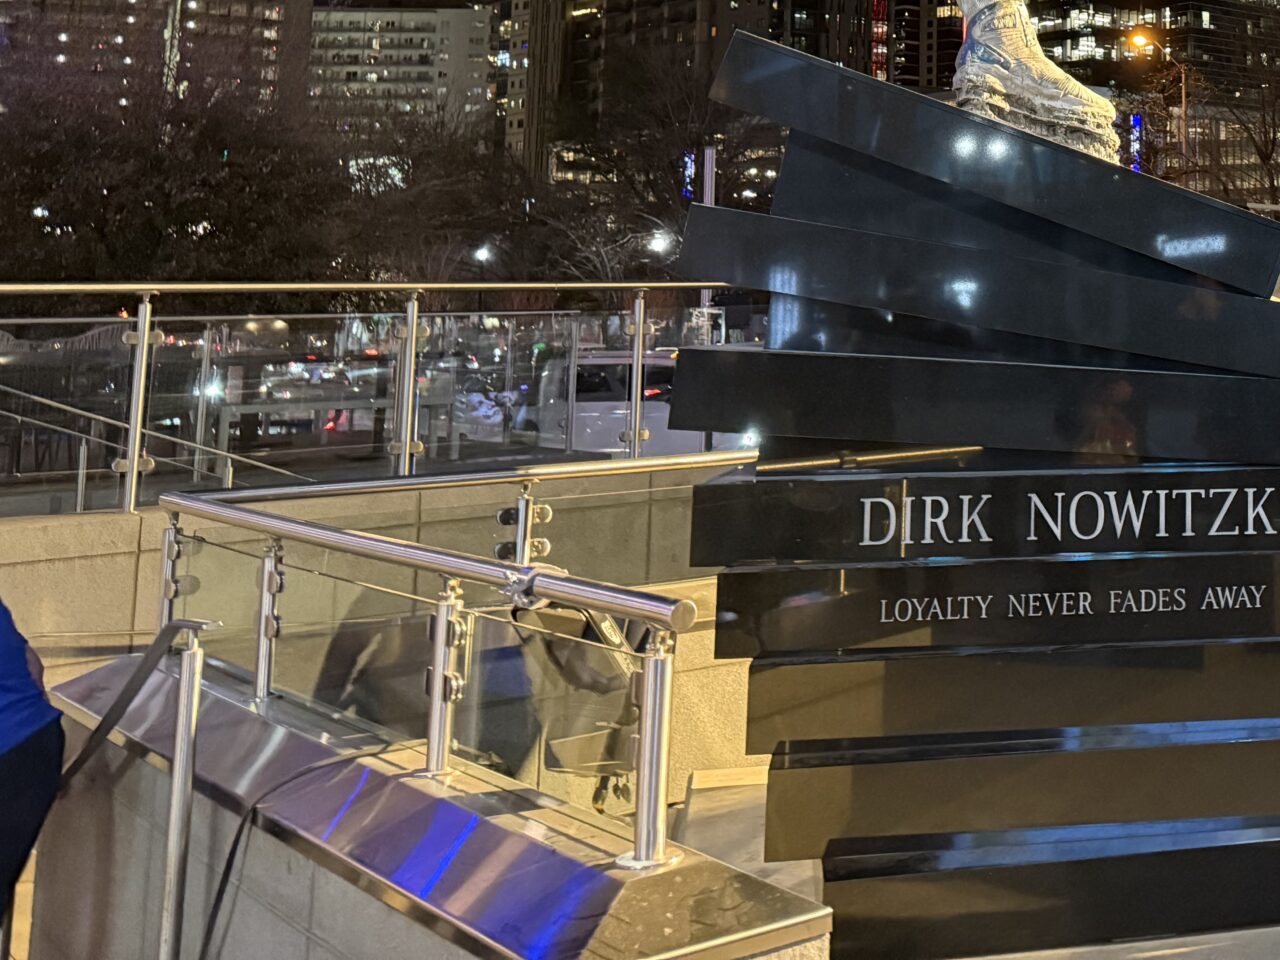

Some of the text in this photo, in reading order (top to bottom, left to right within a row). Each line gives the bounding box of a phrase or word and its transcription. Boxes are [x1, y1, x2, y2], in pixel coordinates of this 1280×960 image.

[860, 494, 993, 546] DIRK
[880, 584, 1267, 623] LOYALTY NEVER FADES AWAY
